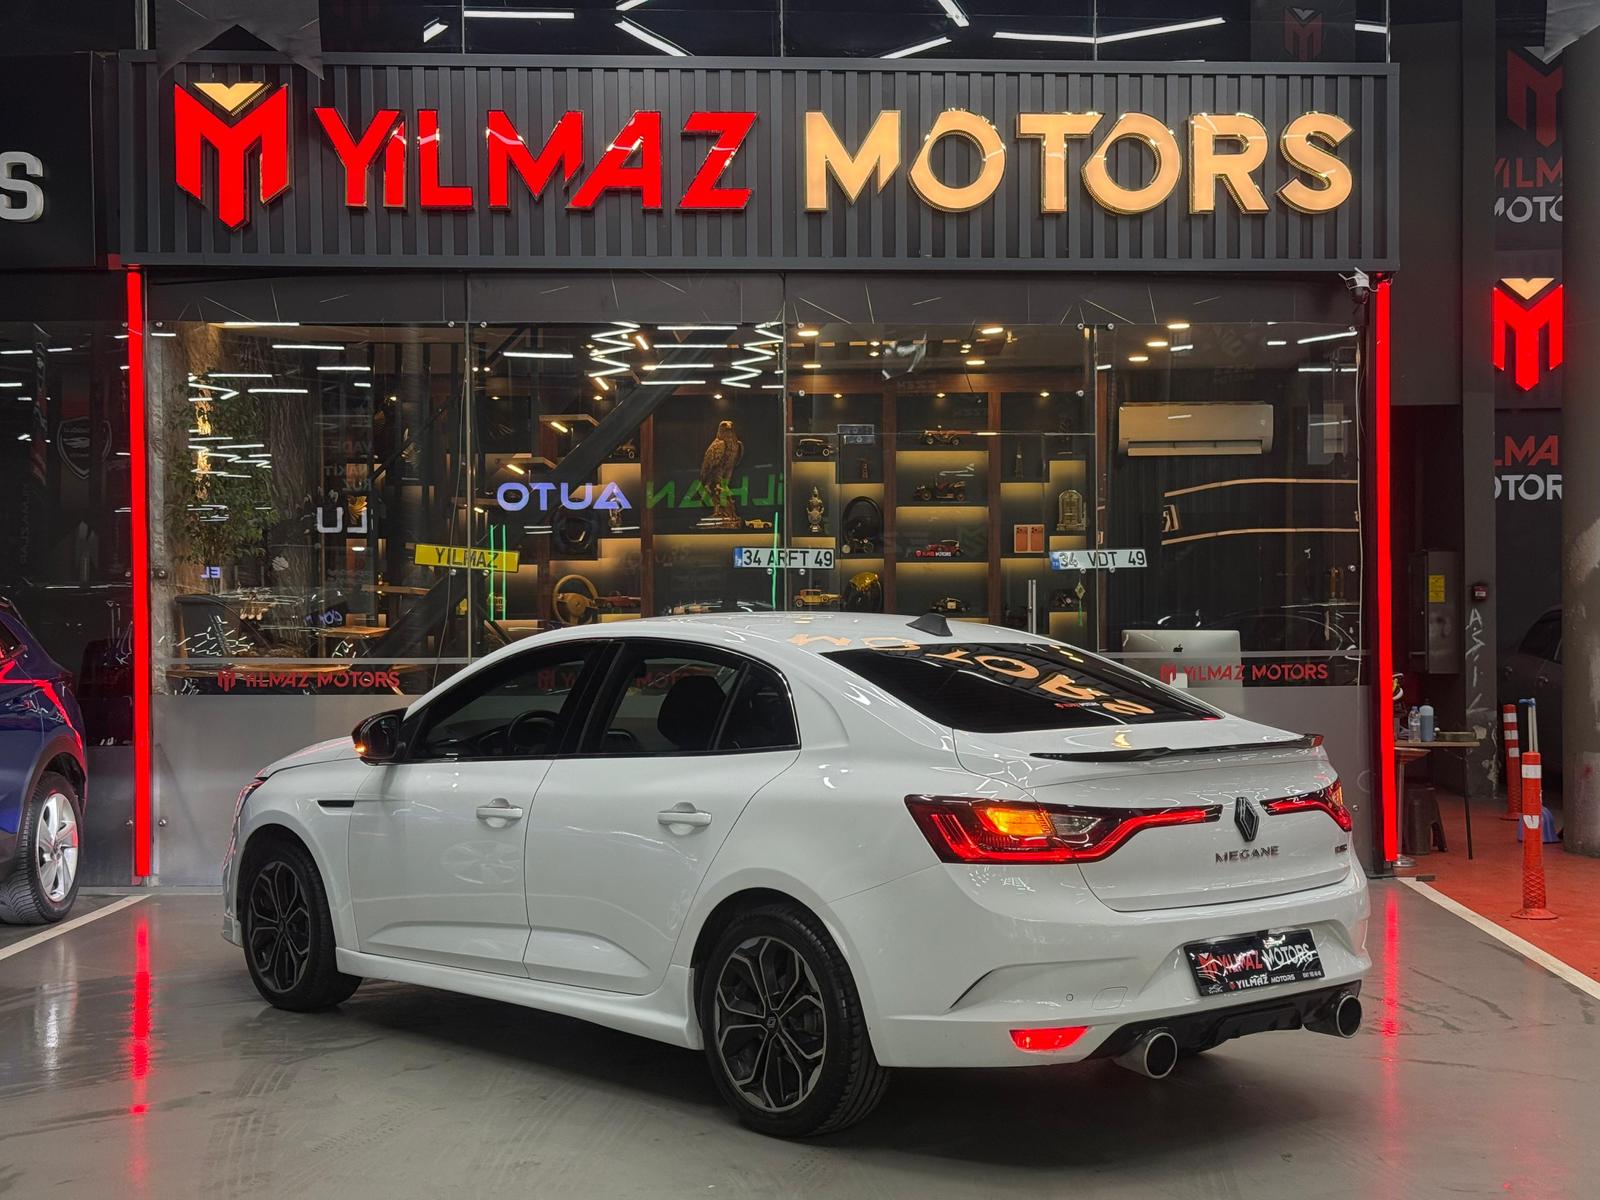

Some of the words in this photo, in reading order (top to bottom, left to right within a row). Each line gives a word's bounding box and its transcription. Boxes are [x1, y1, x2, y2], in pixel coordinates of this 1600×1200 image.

[313, 108, 760, 212] YILMAZ
[804, 106, 1356, 215] MOTORS
[1493, 434, 1559, 466] MA
[1494, 473, 1562, 501] TOR
[435, 547, 499, 568] YILMAZ
[743, 549, 762, 566] 34
[814, 550, 833, 567] 49
[1059, 552, 1078, 567] 34
[1087, 551, 1117, 567] VDT
[1128, 551, 1145, 566] 49
[317, 671, 400, 688] MOTORS
[1252, 663, 1329, 681] MOTORS
[1215, 845, 1280, 863] MEGANE
[1236, 974, 1269, 989] YILMAZ
